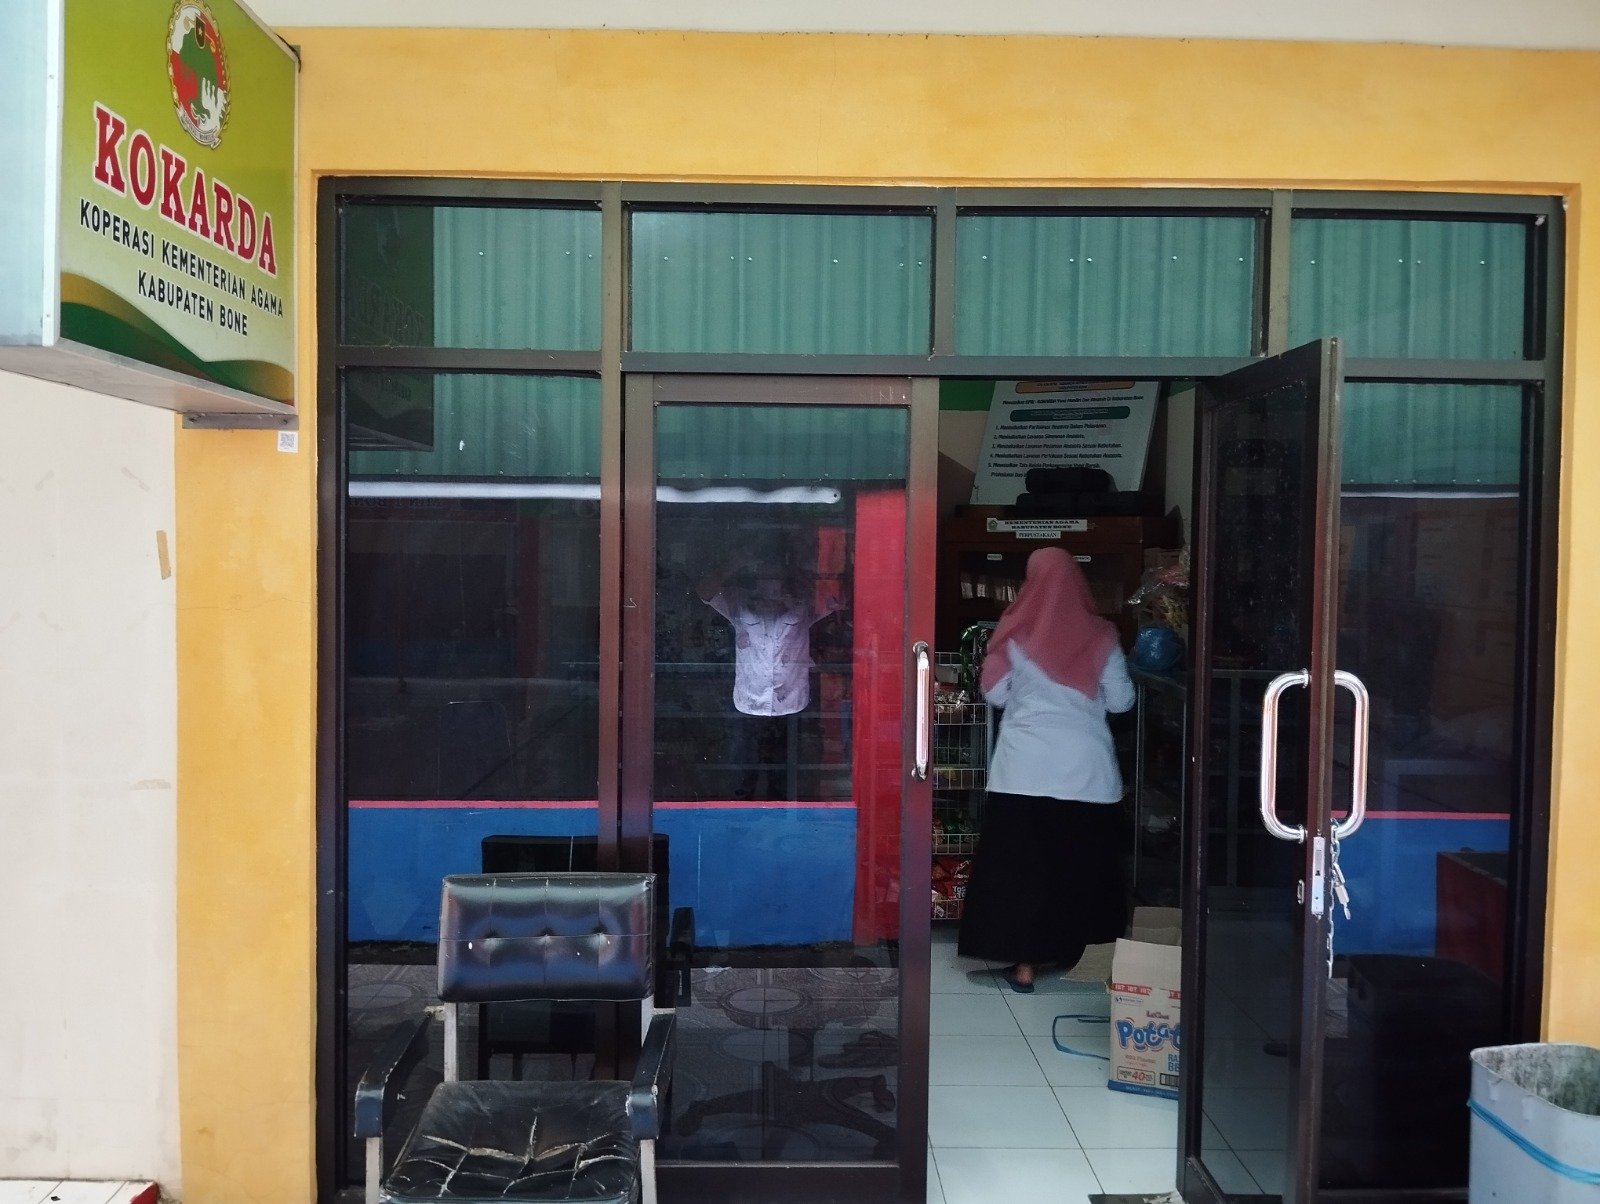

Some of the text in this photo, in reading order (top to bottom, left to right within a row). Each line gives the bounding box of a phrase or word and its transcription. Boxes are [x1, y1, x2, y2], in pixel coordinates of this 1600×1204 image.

[94, 103, 277, 276] KOKARDA
[80, 198, 154, 260] KOPERASI
[162, 241, 246, 301] KEMENTERIAN
[250, 284, 284, 319] AGAMA
[138, 270, 248, 337] KABUPATEN BONE
[1115, 1019, 1180, 1050] Potat
[1168, 1054, 1179, 1063] RA
[1168, 1062, 1180, 1072] BB
